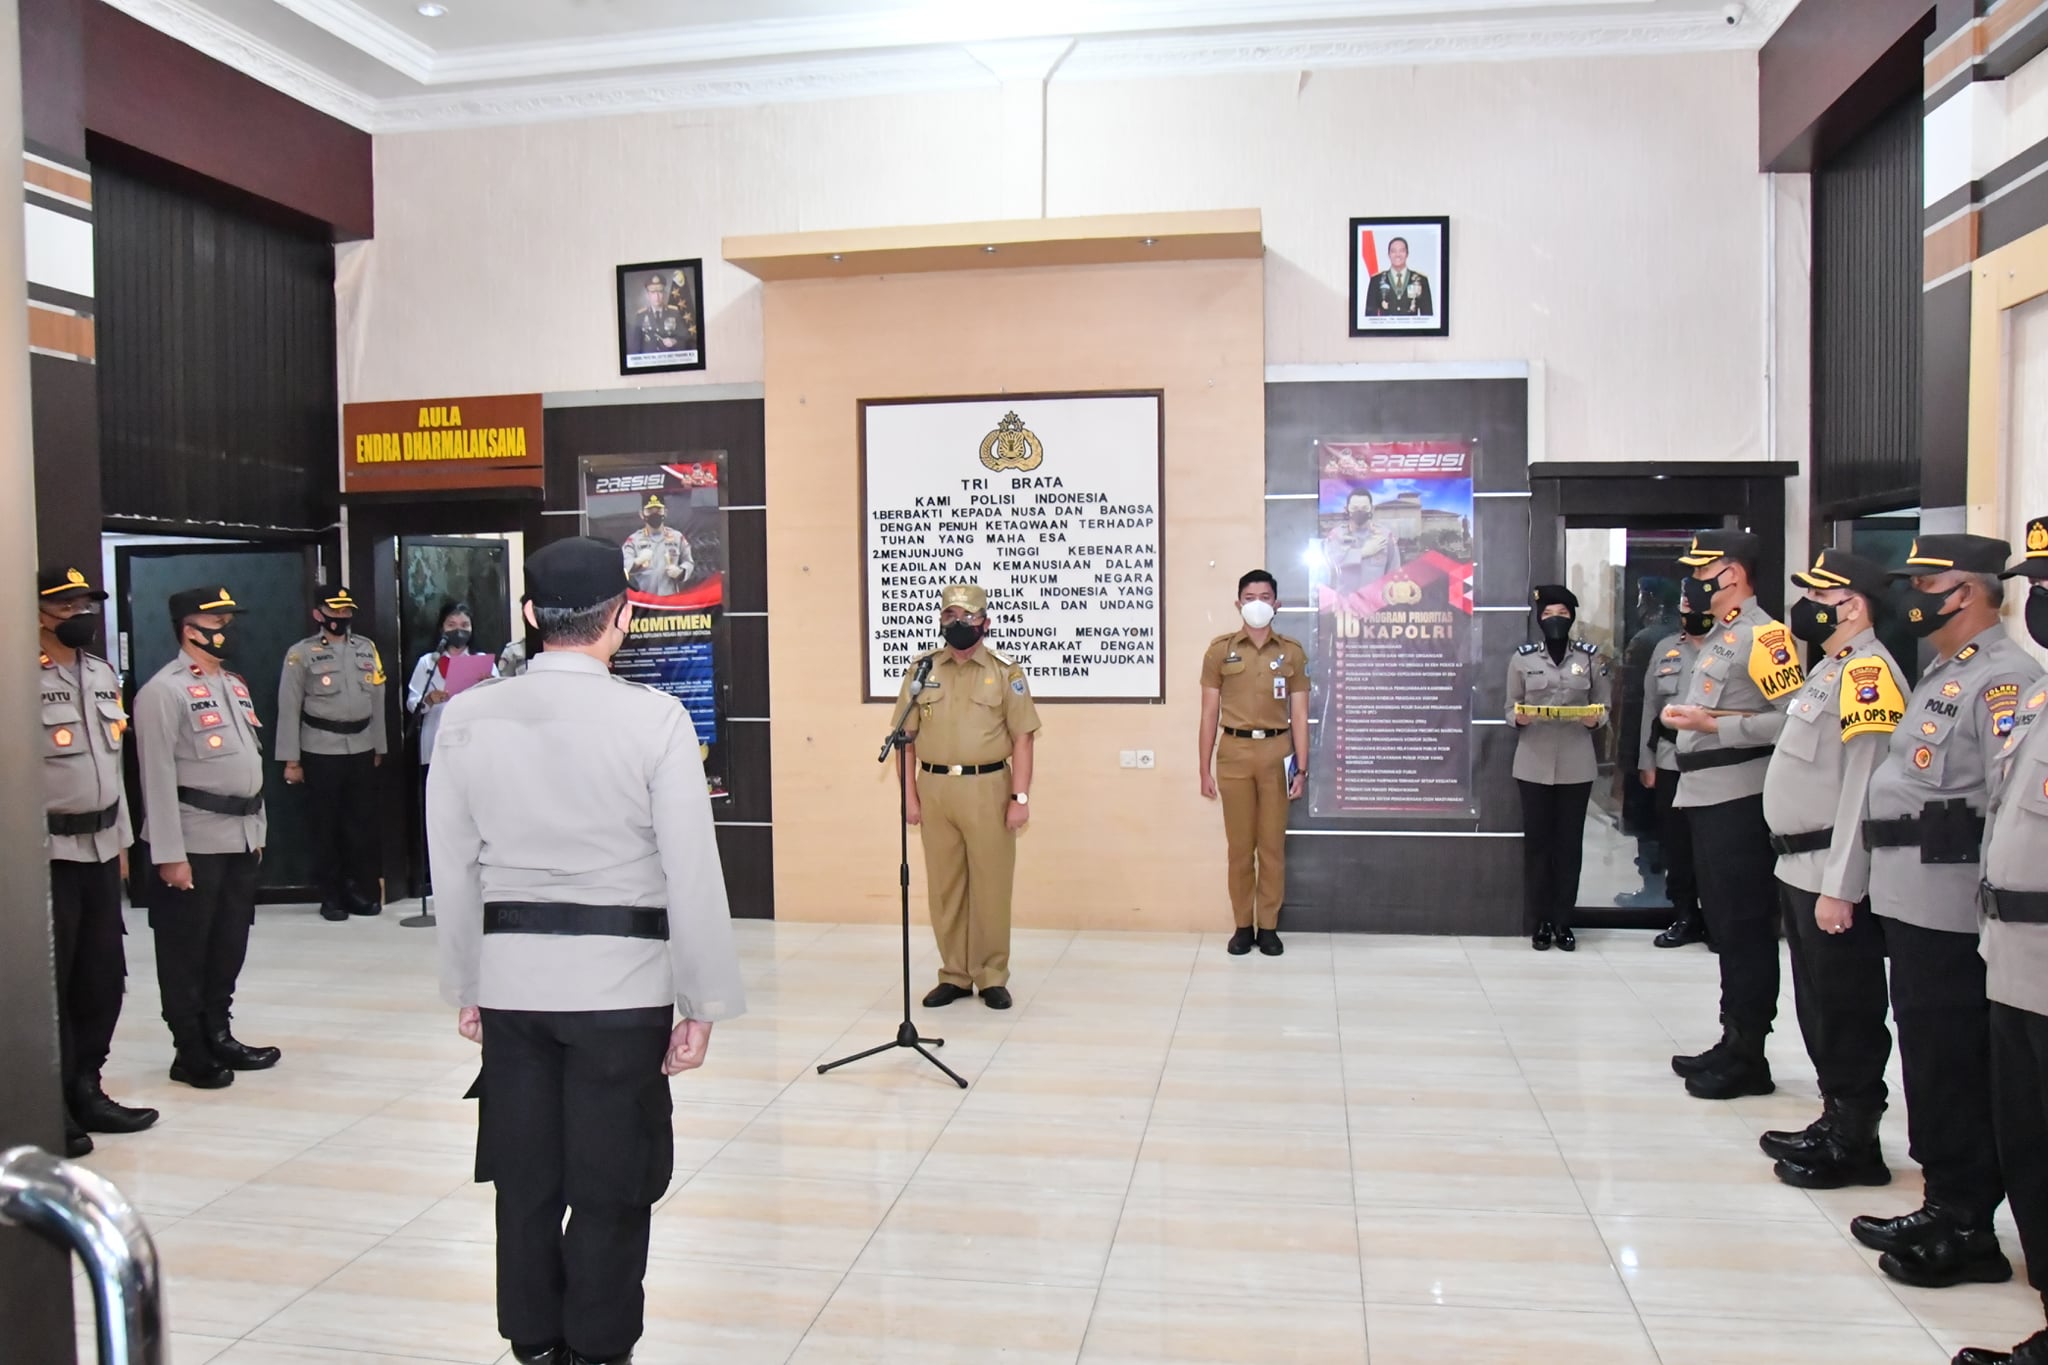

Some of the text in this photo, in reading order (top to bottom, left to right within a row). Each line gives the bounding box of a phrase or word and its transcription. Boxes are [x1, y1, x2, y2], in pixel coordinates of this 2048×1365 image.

[419, 406, 461, 428] AULA
[356, 427, 526, 463] ENDRA DHARMALAKSANA
[1371, 454, 1465, 469] PRESISI
[596, 474, 665, 490] PRESISI
[960, 476, 1064, 491] TRI BRATA
[915, 492, 1108, 508] KAMI POLISI INDONESIA
[951, 506, 1003, 518] KEPADA
[1011, 506, 1046, 517] NUSA
[1054, 505, 1083, 516] DAN
[1099, 504, 1154, 515] BANGSA
[879, 517, 1154, 533] DENGAN PENUH KETAQWAAN TERHADAP
[880, 532, 1067, 546] TUHAN YANG MAHA ESA
[996, 546, 1039, 557] TINGGI
[881, 558, 1154, 573] KEADILAN DAN KEMANUSIAAN DALAM
[881, 572, 1154, 587] MENEGAKKAN HUKUM NEGARA
[881, 585, 1154, 599] KESATUA UBLIK INDONESIA YANG
[882, 599, 1154, 612] BERDASA ANCASILA DAN UNDANG
[630, 614, 711, 633] KOMITMEN
[881, 613, 1024, 626] UNDANG 1945
[1075, 626, 1154, 637] MENGAYOMI
[1363, 625, 1453, 639] KAPOLRI
[882, 641, 909, 652] DAN
[996, 640, 1082, 651] MASYARAKAT
[1100, 640, 1154, 651] DENGAN
[1062, 654, 1155, 665] MEWUJUDKAN
[1025, 666, 1089, 676] TERTIBAN
[1760, 674, 1779, 696] KA
[1776, 666, 1798, 689] OPS
[1863, 708, 1887, 722] OPS
[1924, 698, 1958, 718] POLRI
